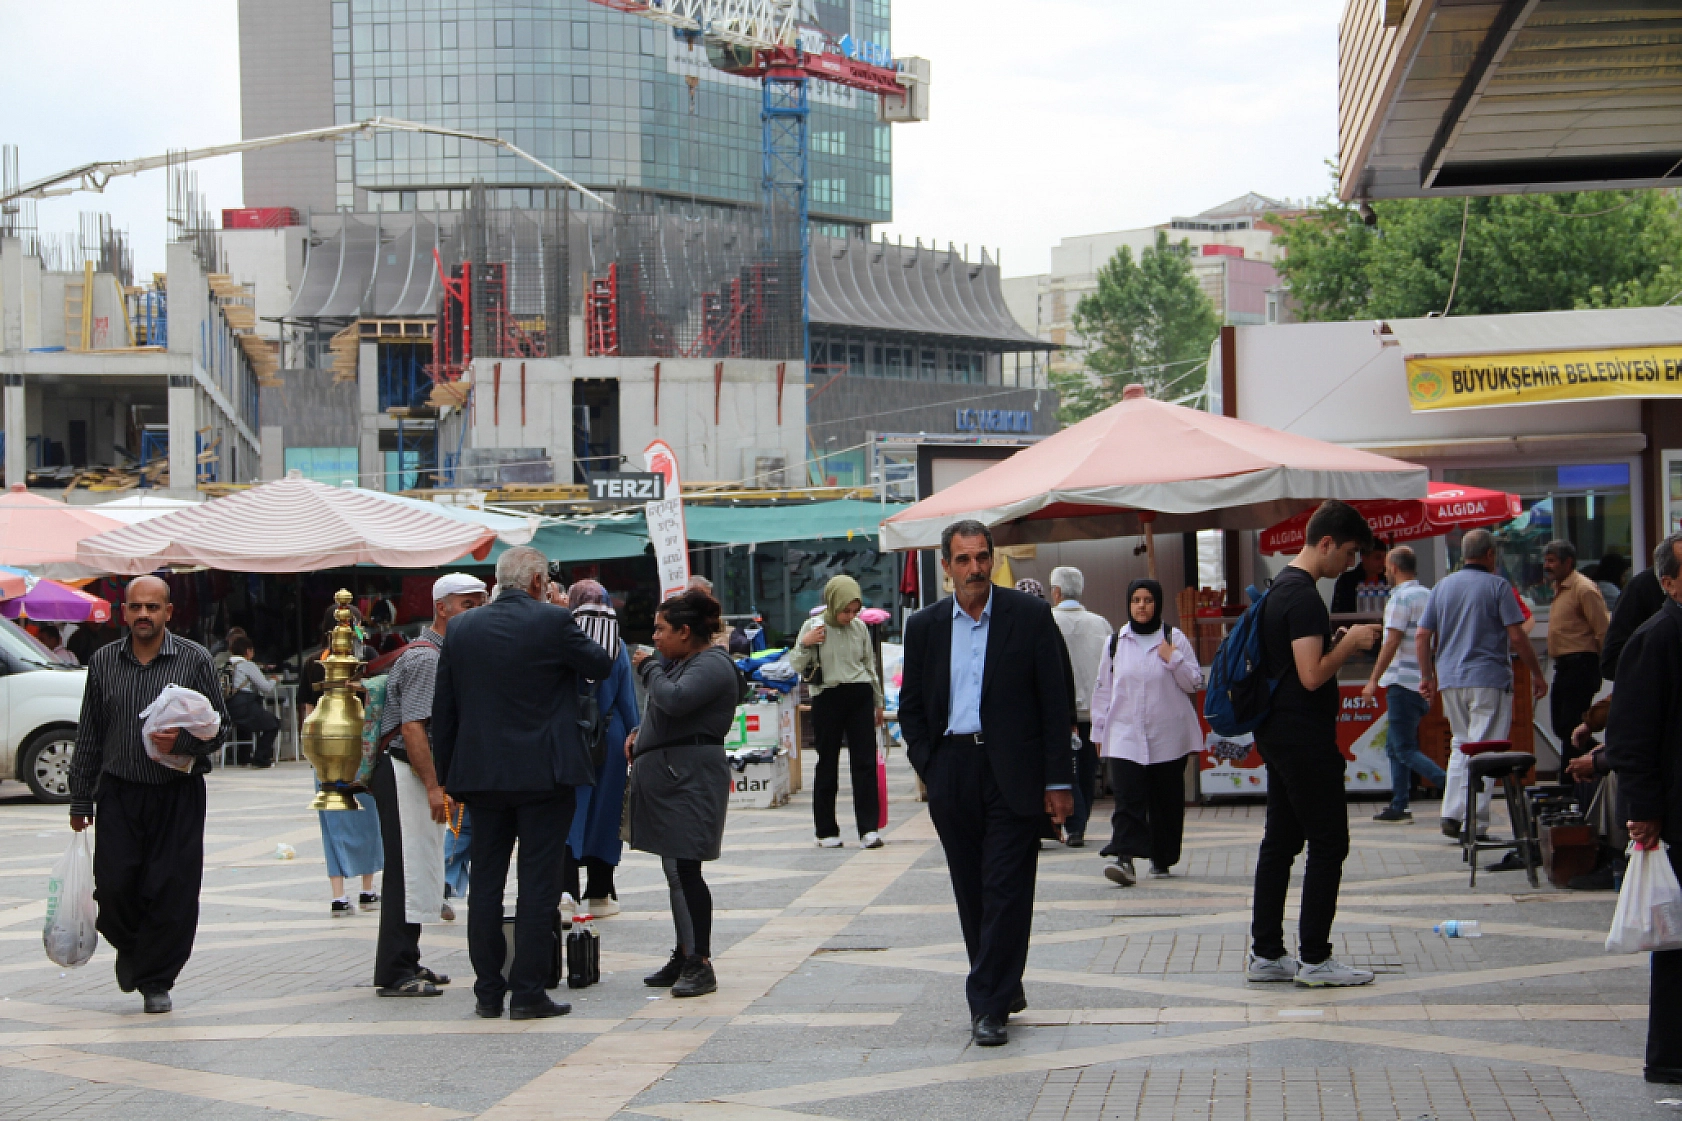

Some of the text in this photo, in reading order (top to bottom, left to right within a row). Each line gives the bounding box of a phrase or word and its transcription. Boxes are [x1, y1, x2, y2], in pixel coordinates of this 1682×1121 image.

[1452, 360, 1564, 396] BÜYÜKŞEHİR
[1564, 355, 1659, 385] BELEDİYESİ
[592, 475, 661, 498] TERZİ
[1437, 501, 1486, 517] ALGIDA
[1367, 514, 1406, 530] GIDA
[1269, 530, 1303, 546] ALGIDA
